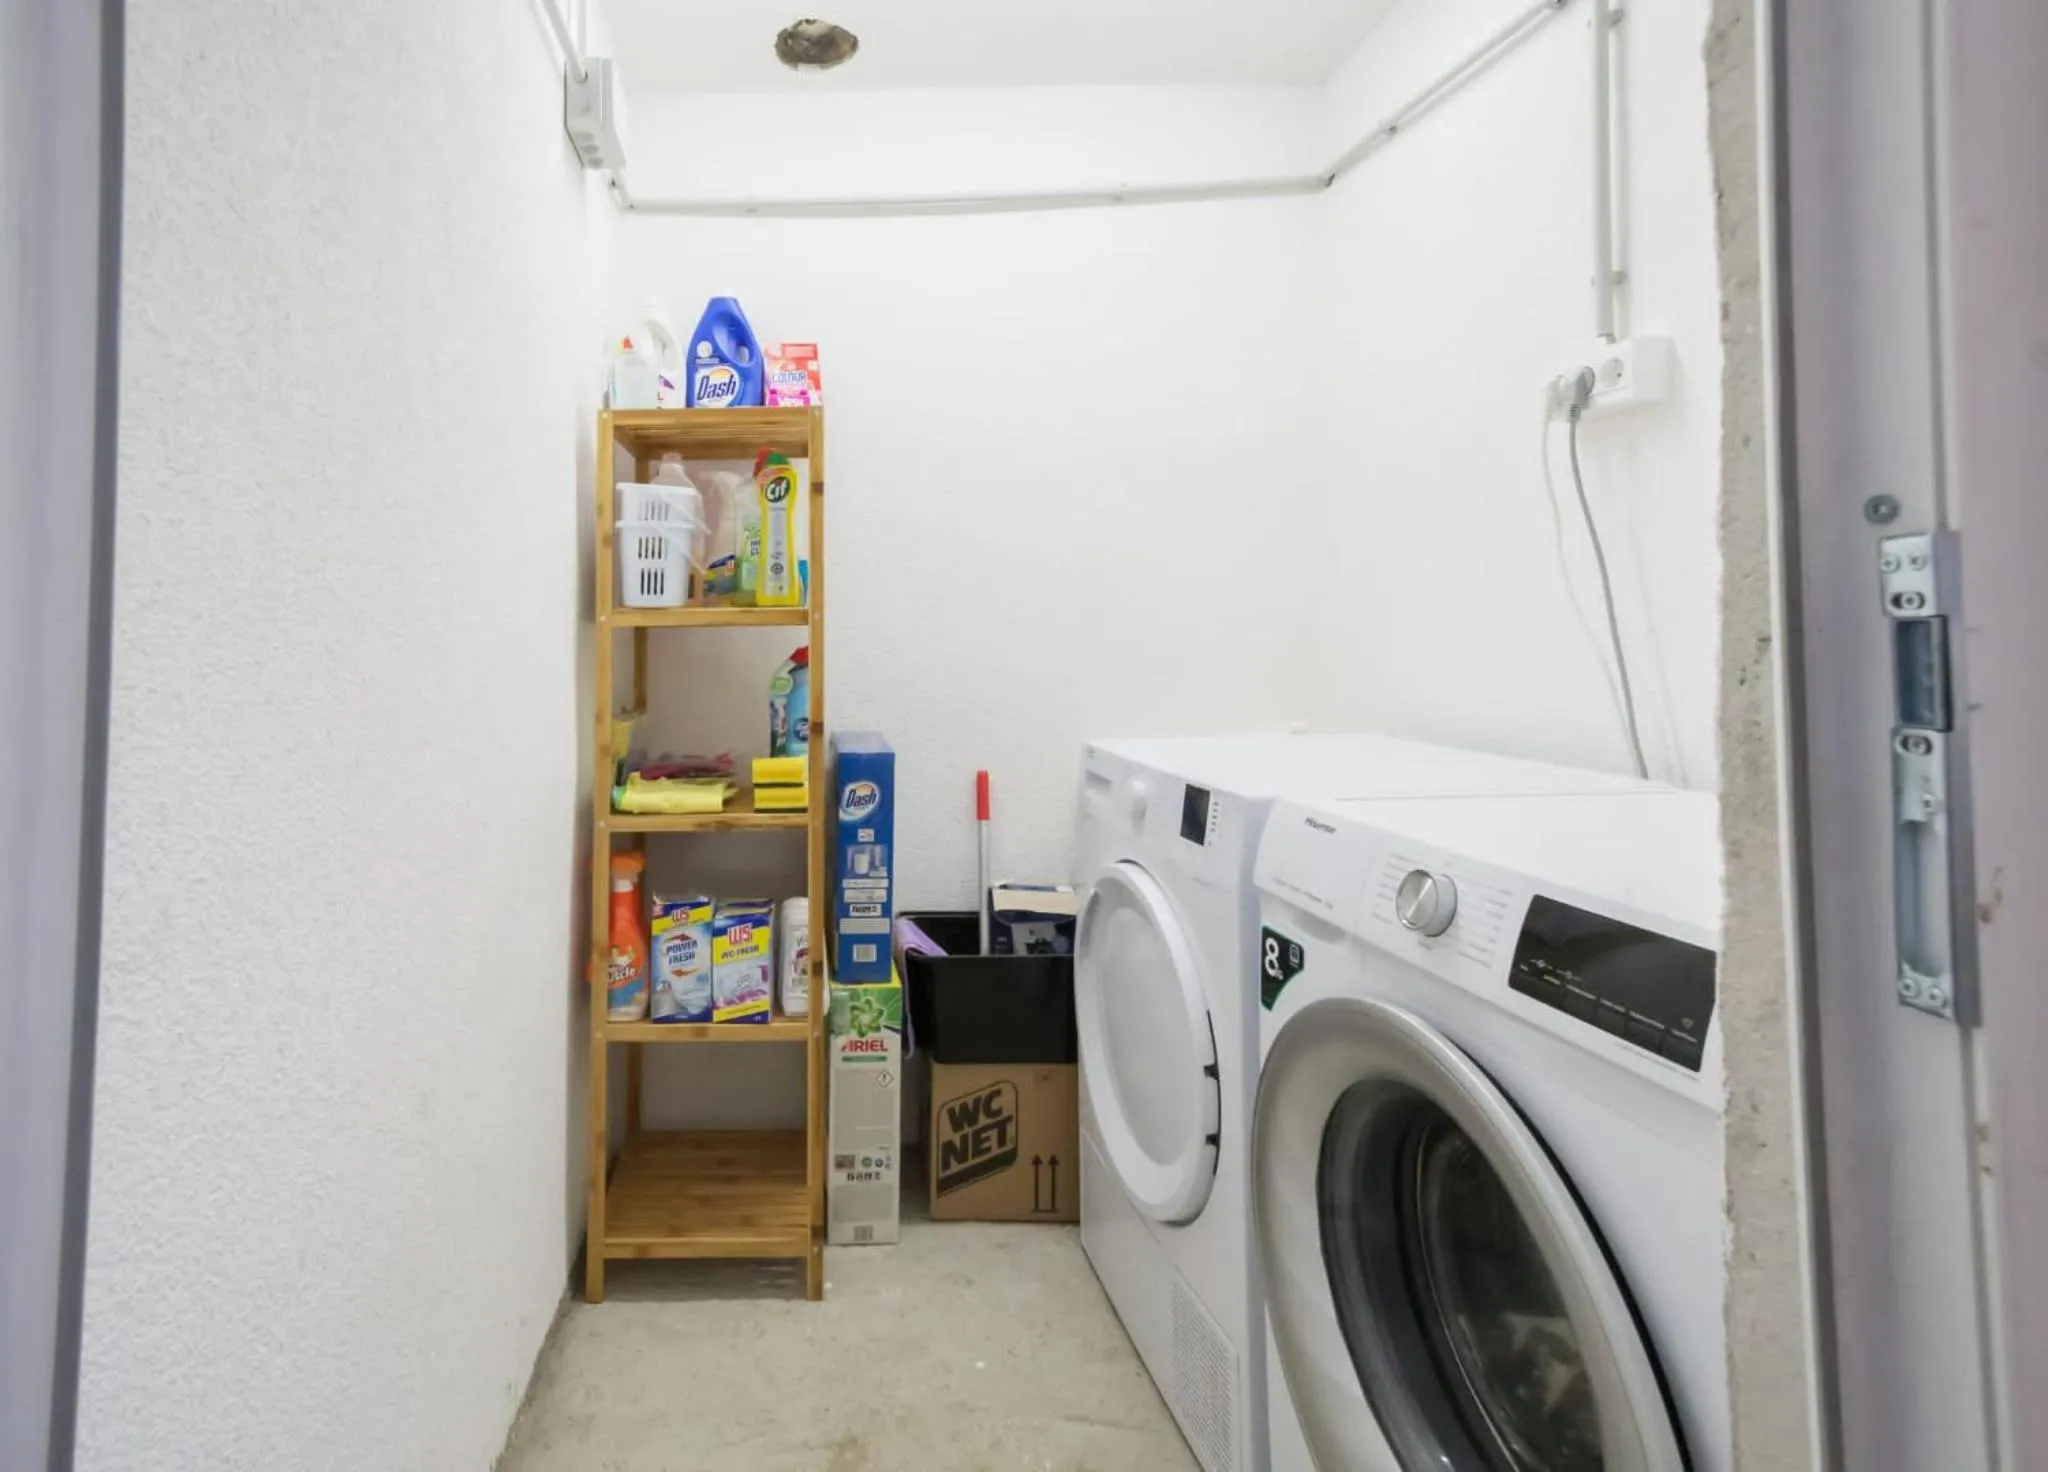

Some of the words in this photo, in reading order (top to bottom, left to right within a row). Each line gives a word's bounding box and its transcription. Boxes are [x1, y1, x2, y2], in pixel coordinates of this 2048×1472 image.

[697, 373, 736, 401] Dash
[766, 478, 787, 500] Cif
[845, 788, 878, 809] Dash
[667, 939, 698, 955] POWER
[668, 951, 696, 965] FRESH
[841, 1039, 888, 1053] ARIEL
[947, 1088, 1004, 1134] WC
[941, 1114, 1013, 1174] NET
